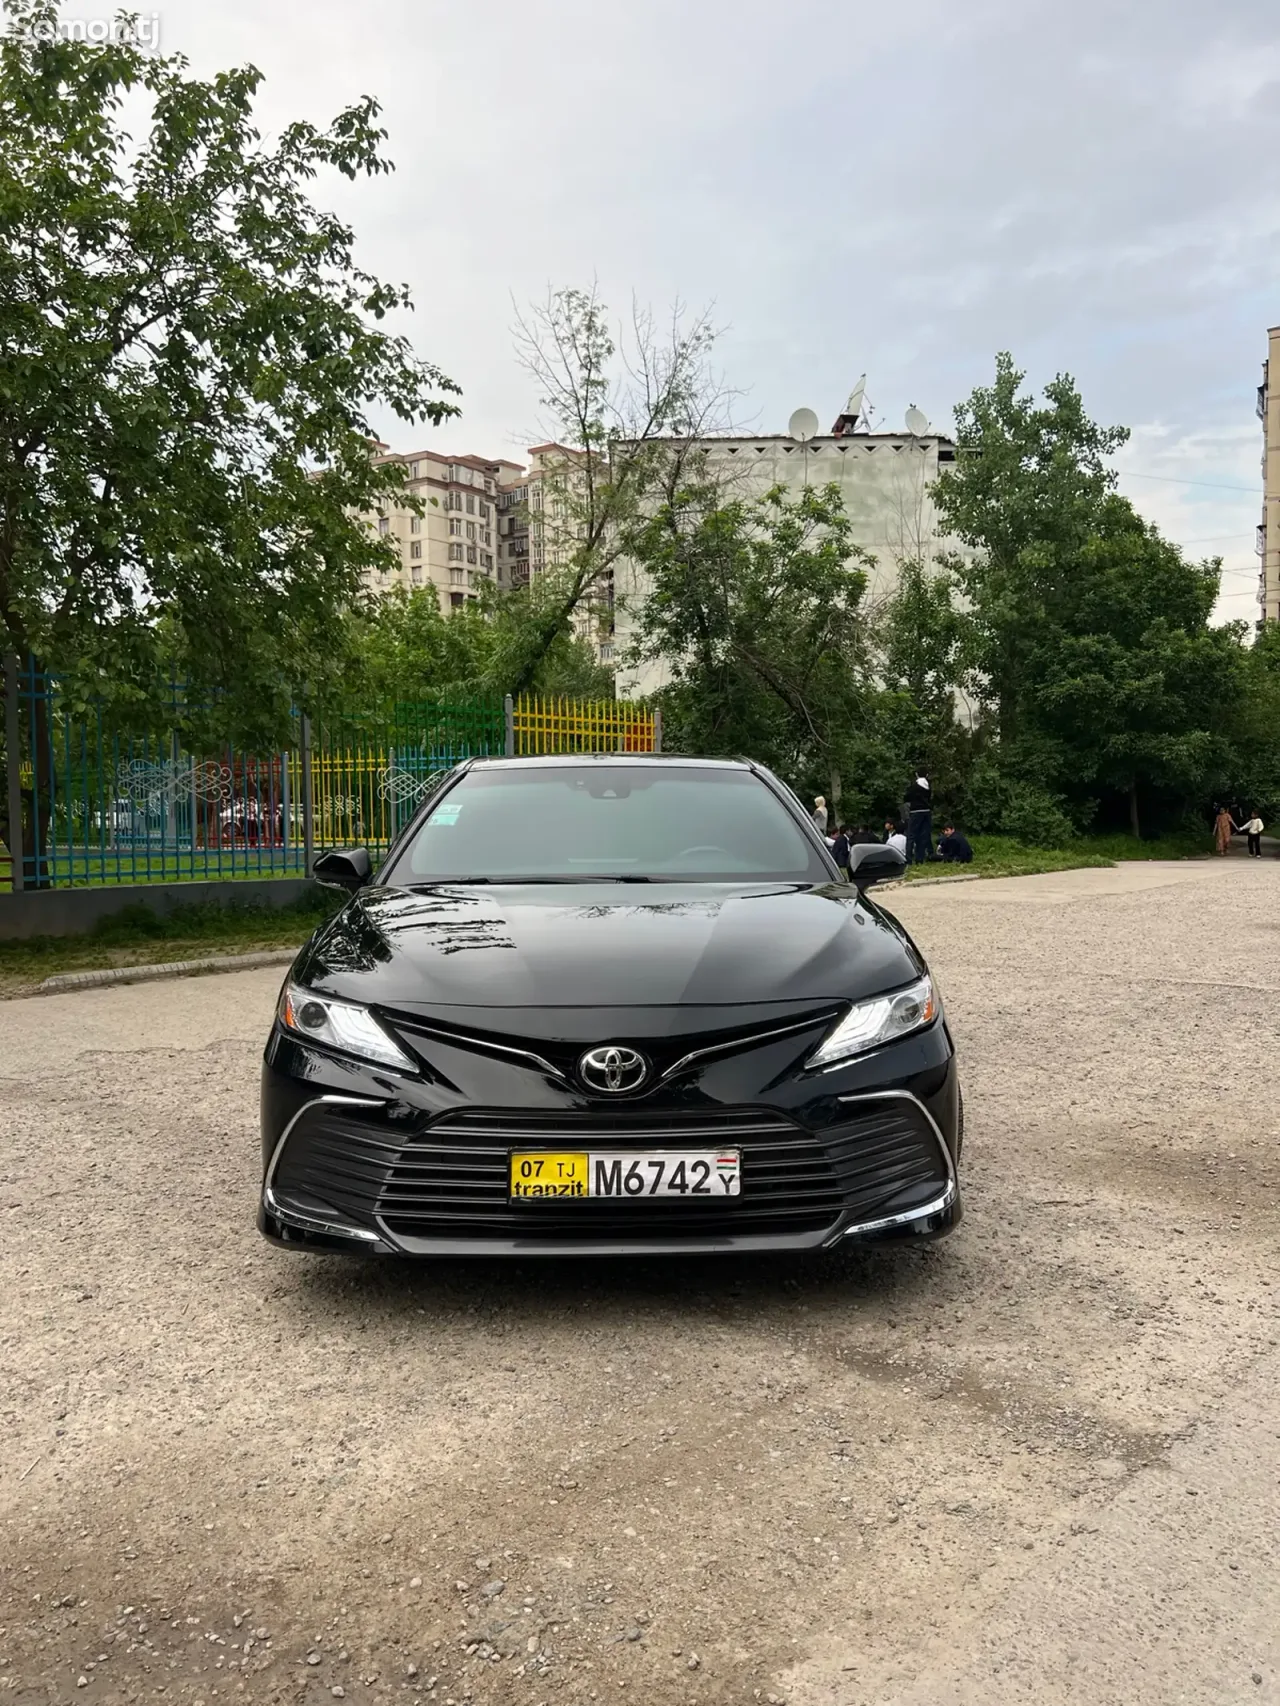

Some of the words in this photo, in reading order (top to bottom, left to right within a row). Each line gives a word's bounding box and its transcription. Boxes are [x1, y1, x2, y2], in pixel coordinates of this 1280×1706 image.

[520, 1160, 545, 1178] 07
[556, 1162, 576, 1178] TJ
[595, 1160, 711, 1196] M6742
[514, 1180, 583, 1197] tranzit
